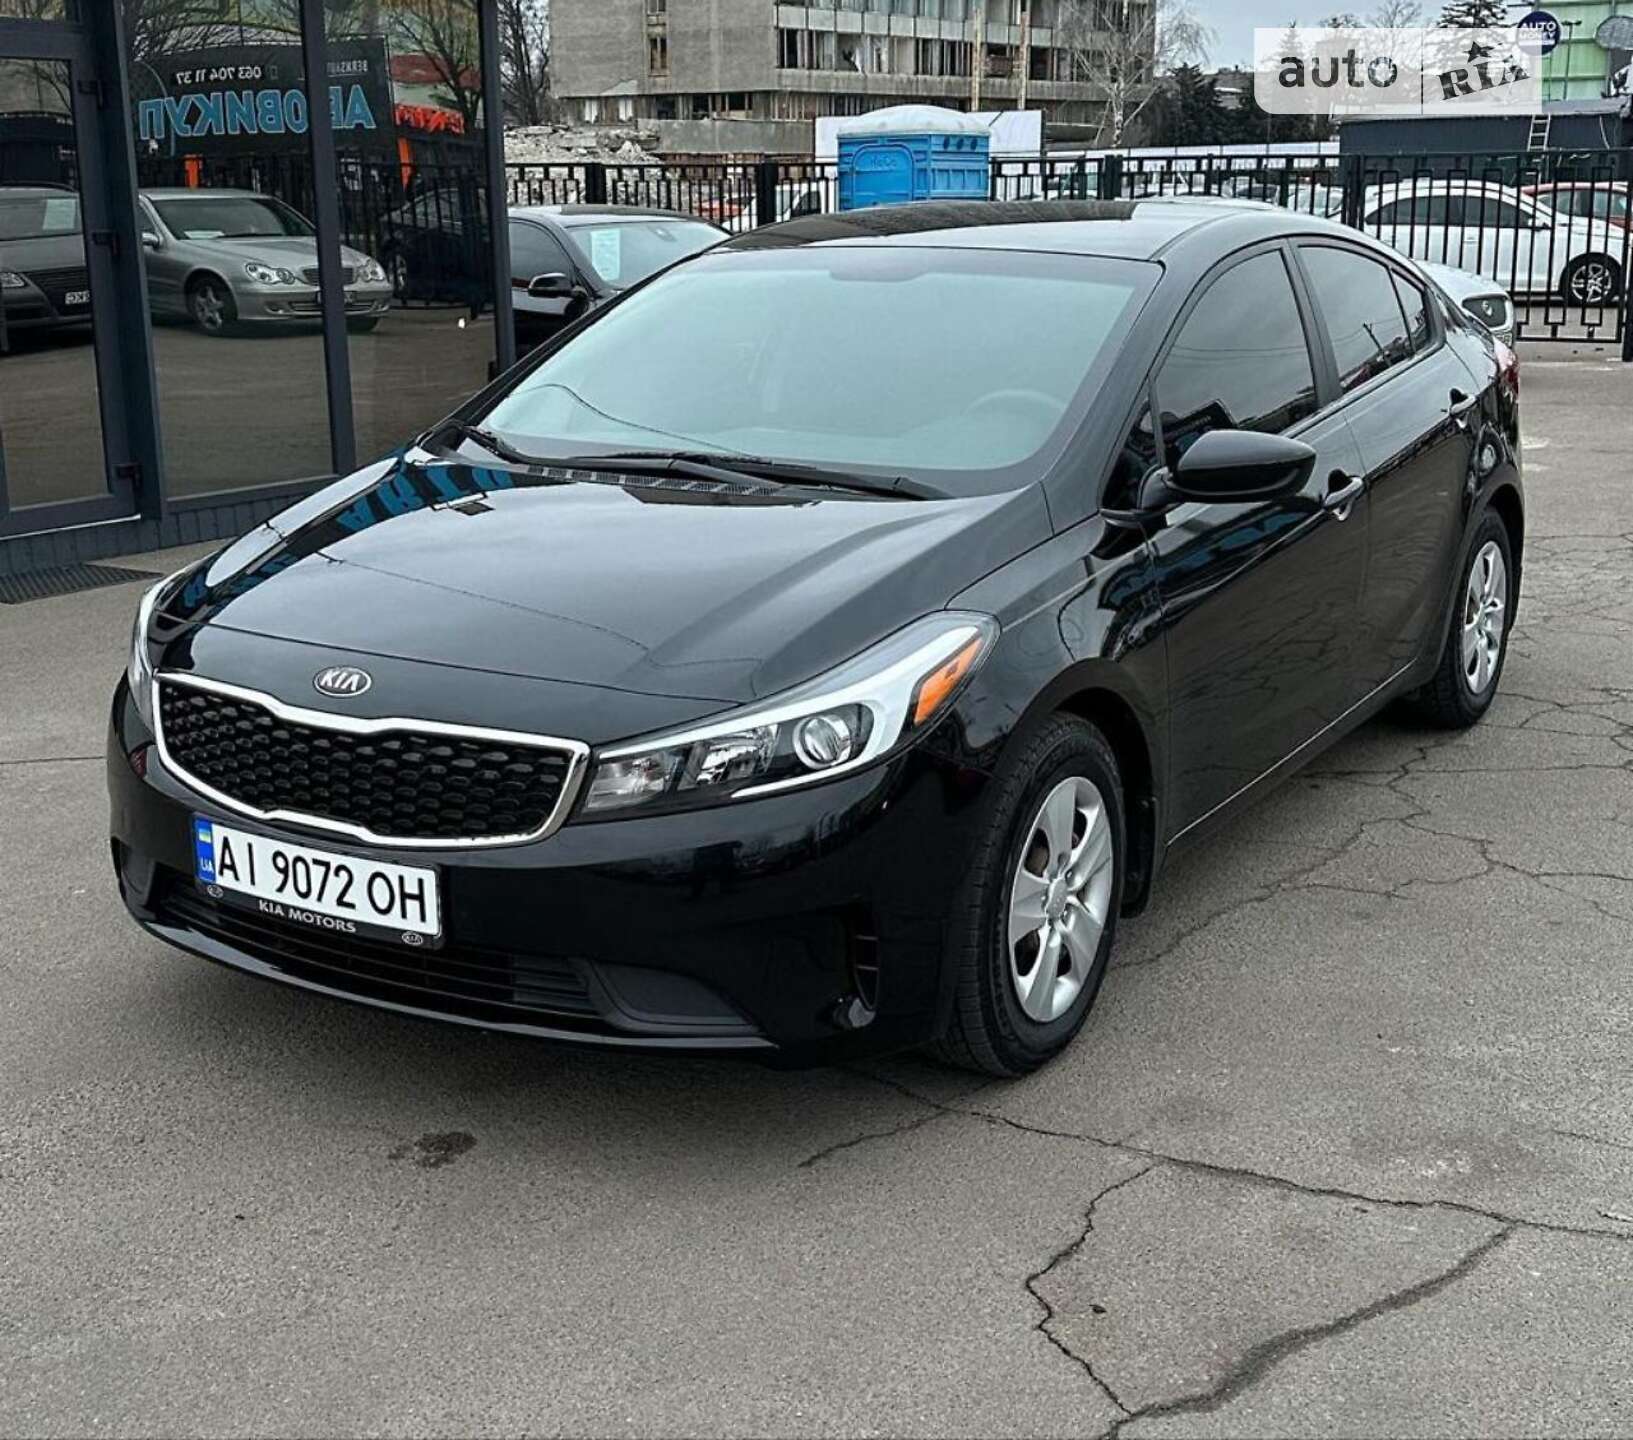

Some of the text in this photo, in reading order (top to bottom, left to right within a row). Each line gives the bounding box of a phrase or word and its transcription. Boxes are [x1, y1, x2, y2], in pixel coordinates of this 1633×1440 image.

[1520, 21, 1557, 31] AUTO
[318, 668, 363, 693] KIA
[272, 850, 356, 910] 9072
[367, 871, 427, 923] OH
[259, 899, 357, 934] KIA MOTORS
